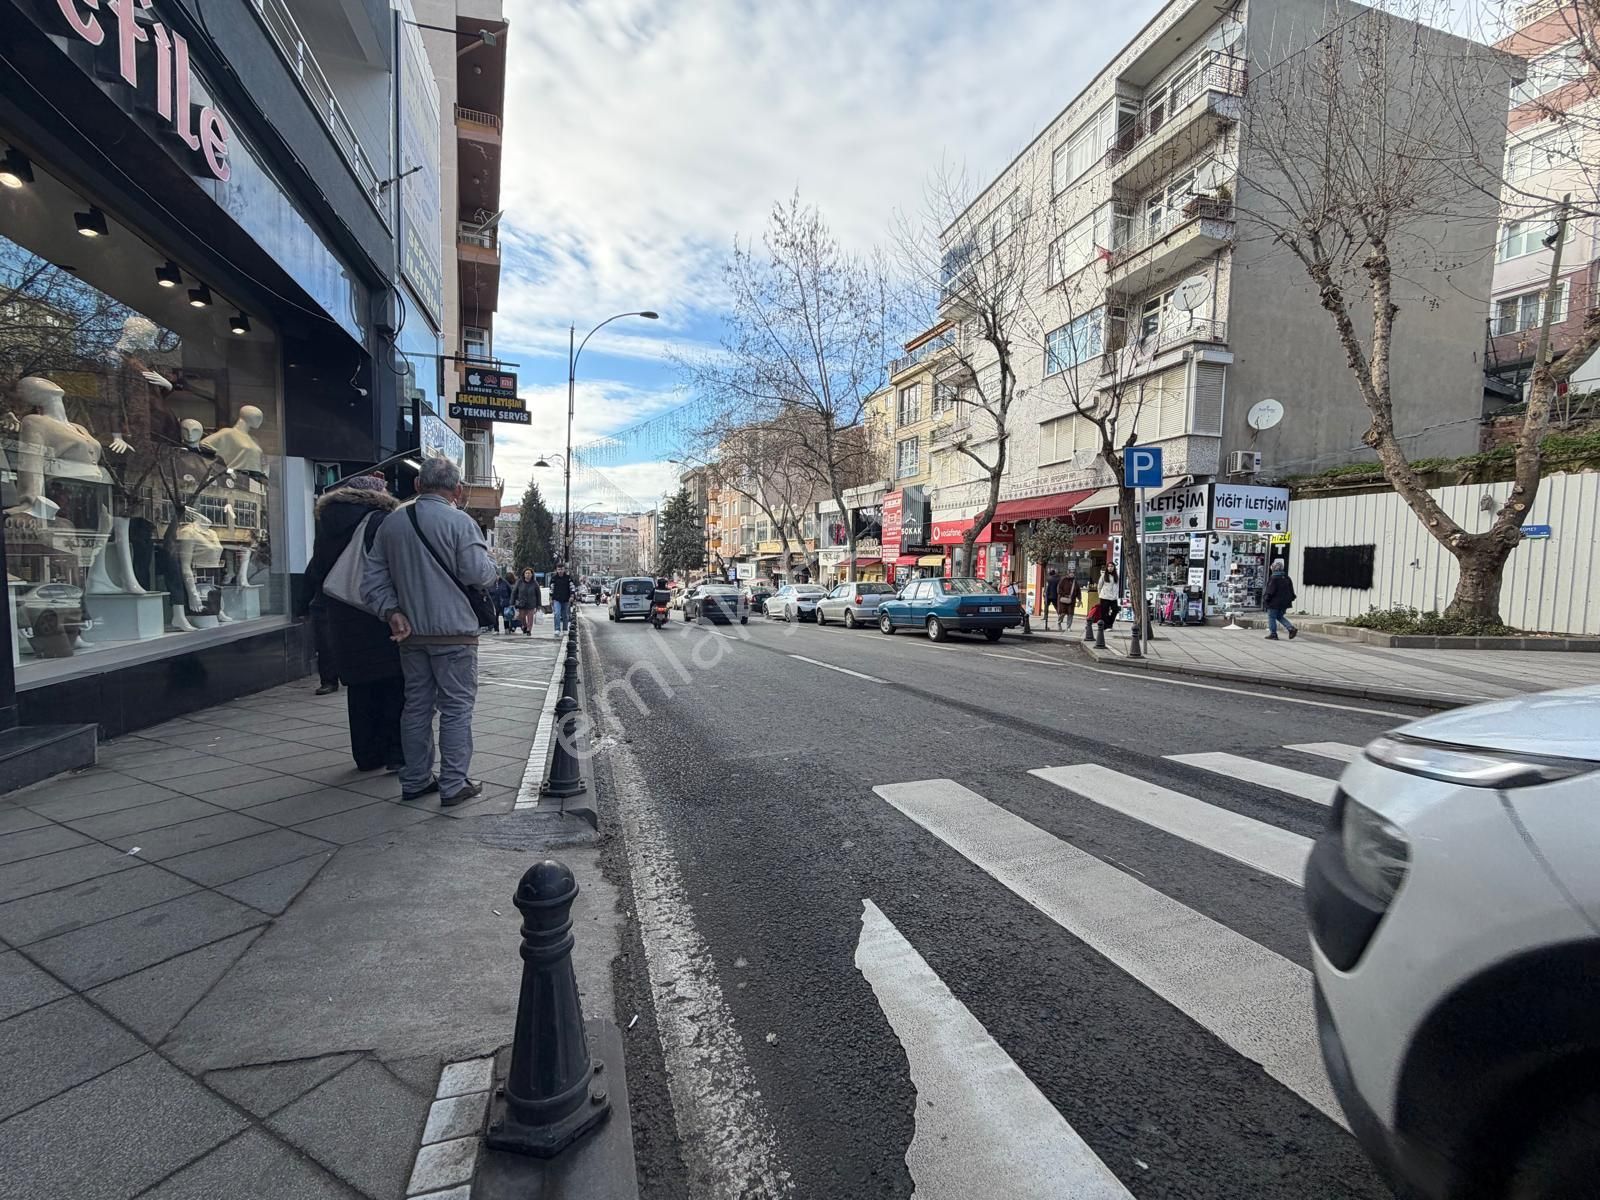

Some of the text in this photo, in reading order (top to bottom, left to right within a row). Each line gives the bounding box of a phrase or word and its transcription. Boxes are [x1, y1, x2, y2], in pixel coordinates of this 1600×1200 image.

[463, 407, 529, 422] TEKNİK SERVİS
[1133, 452, 1154, 484] P
[1216, 493, 1288, 513] YİĞİT İLETİŞİM
[900, 527, 922, 535] SOKAK
[940, 528, 962, 537] vodafone
[1162, 533, 1190, 542] SHO
